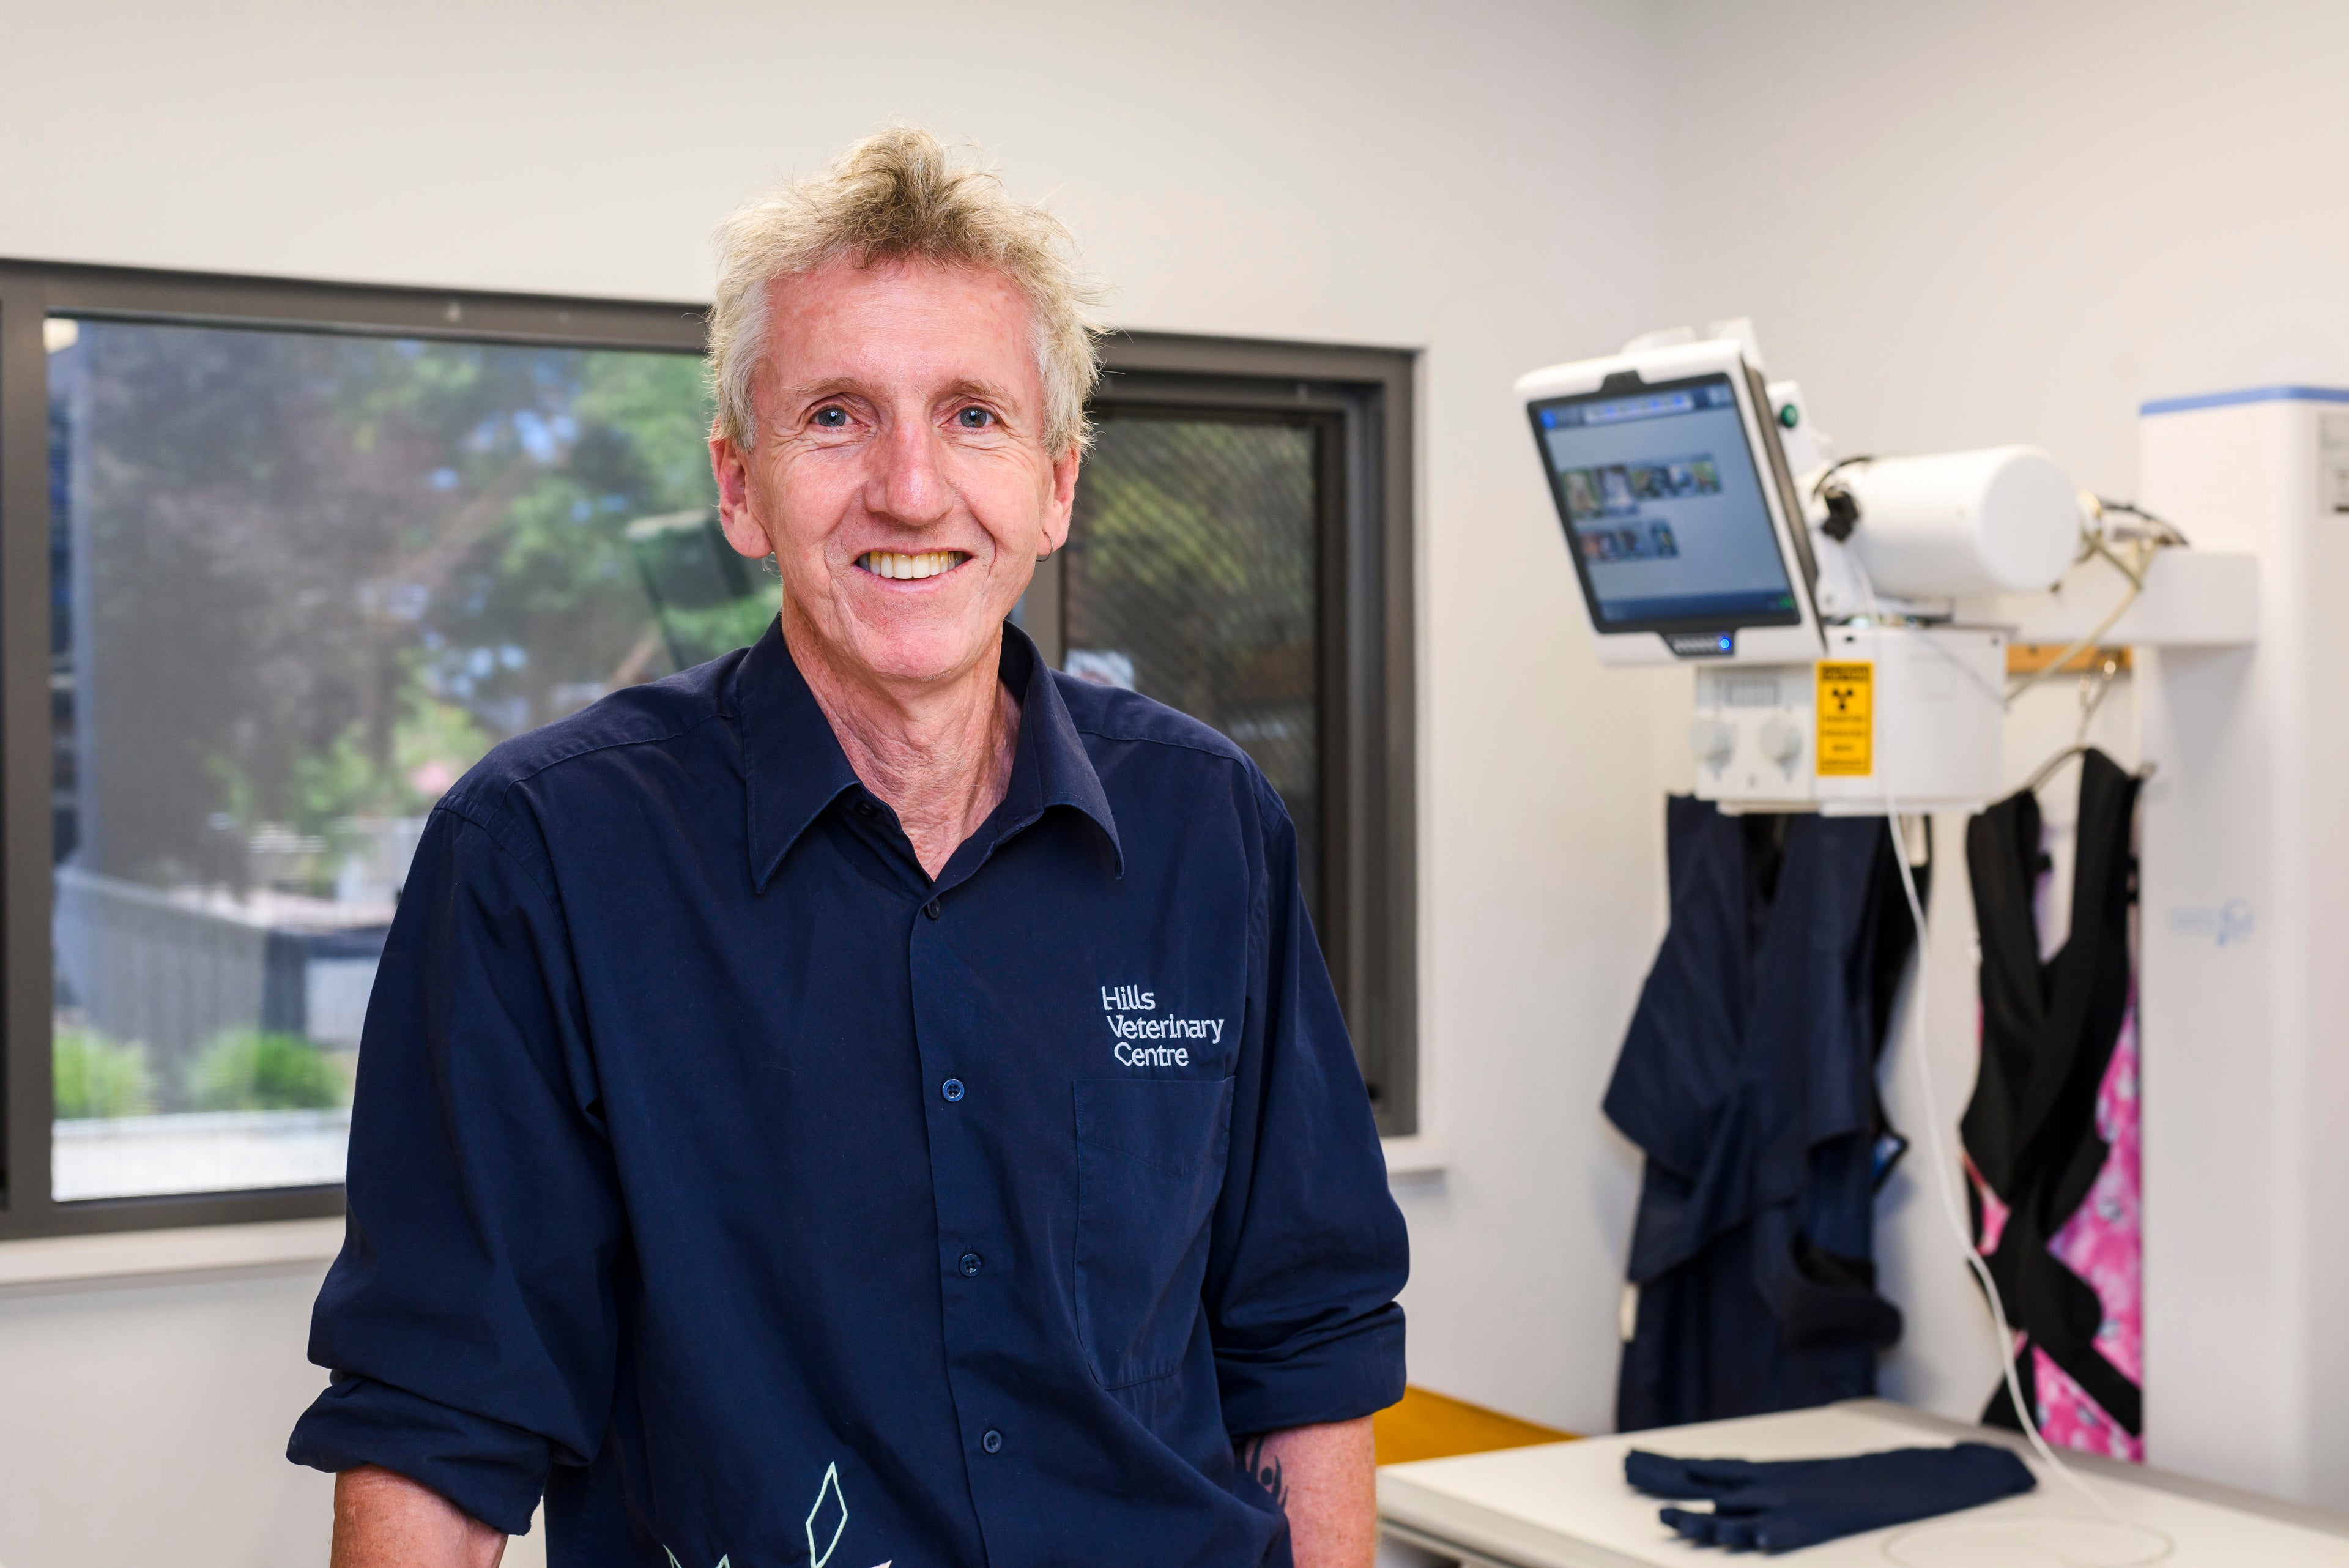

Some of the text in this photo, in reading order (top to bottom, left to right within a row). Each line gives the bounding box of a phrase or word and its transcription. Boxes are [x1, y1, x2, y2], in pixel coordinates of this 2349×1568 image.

[1102, 984, 1156, 1010] Hills
[1106, 1014, 1225, 1044] Veterinary
[1114, 1042, 1189, 1066] Centre
